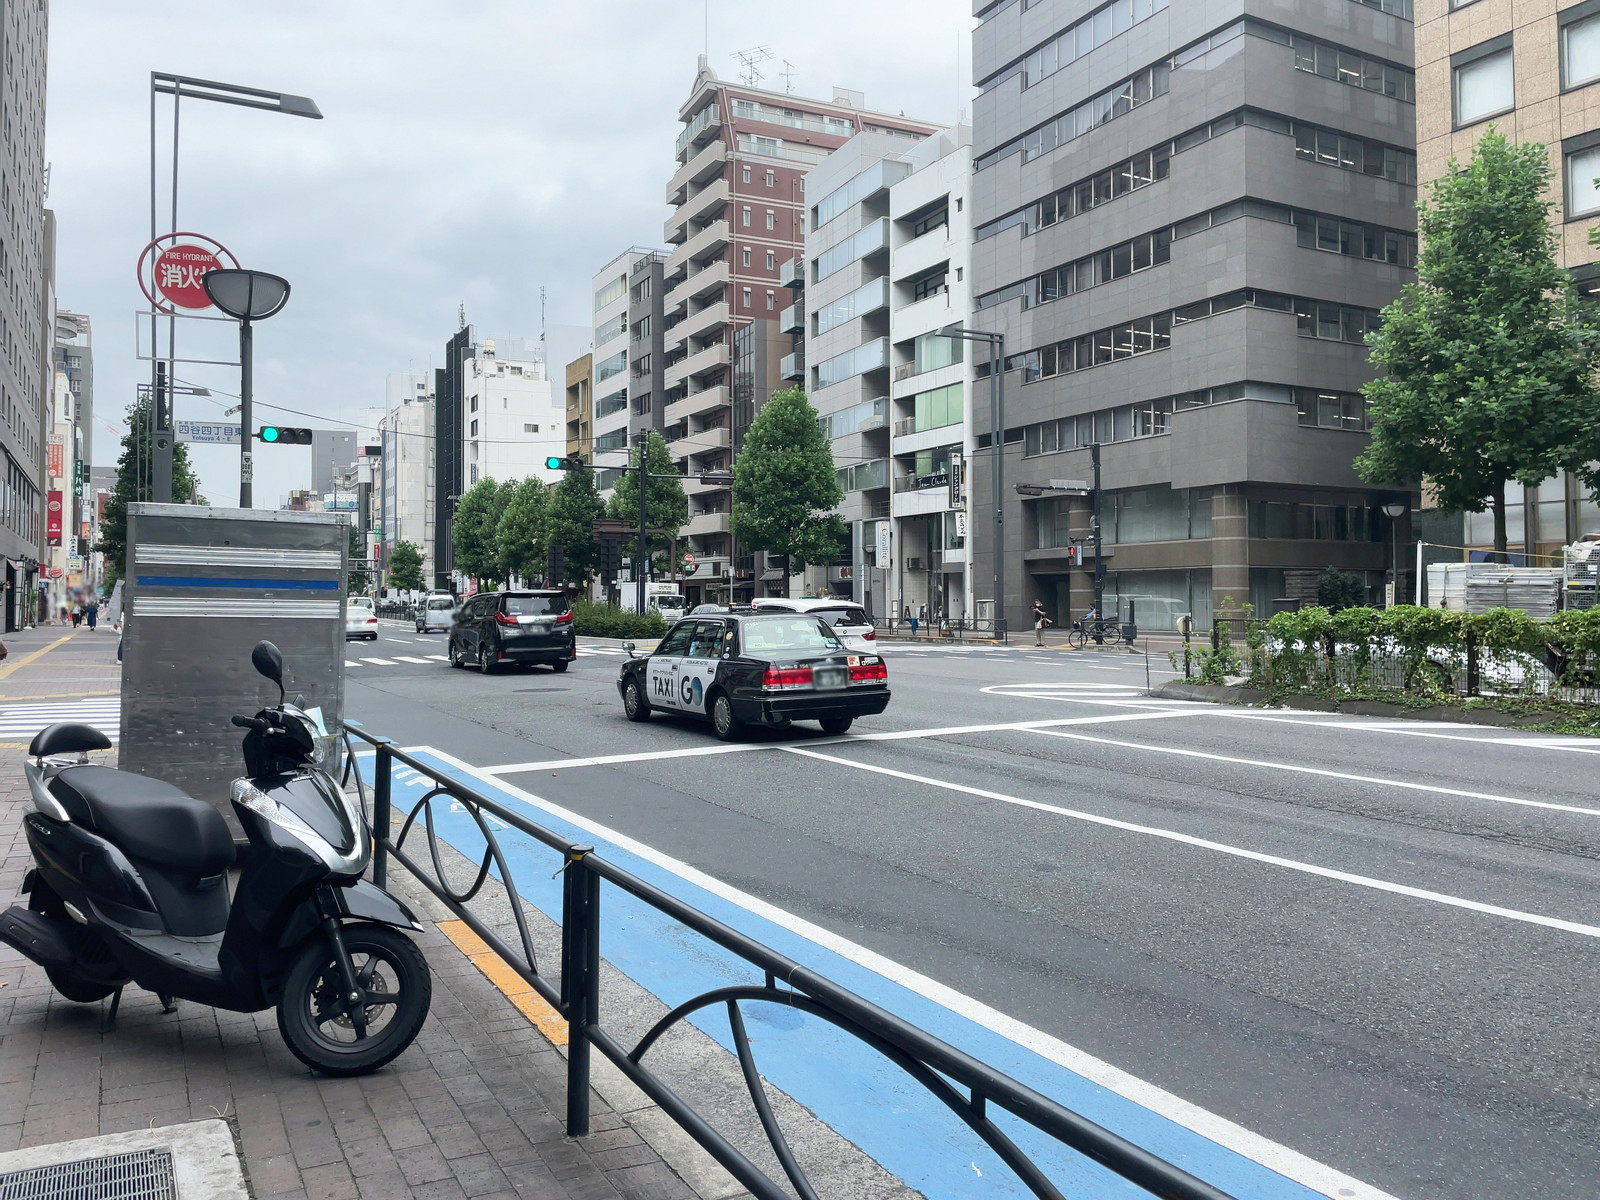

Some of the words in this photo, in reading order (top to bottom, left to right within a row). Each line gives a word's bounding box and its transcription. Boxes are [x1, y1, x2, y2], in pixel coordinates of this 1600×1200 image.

[165, 252, 181, 260] FIRE
[182, 253, 214, 262] HYDRANT
[653, 676, 673, 697] TAXI
